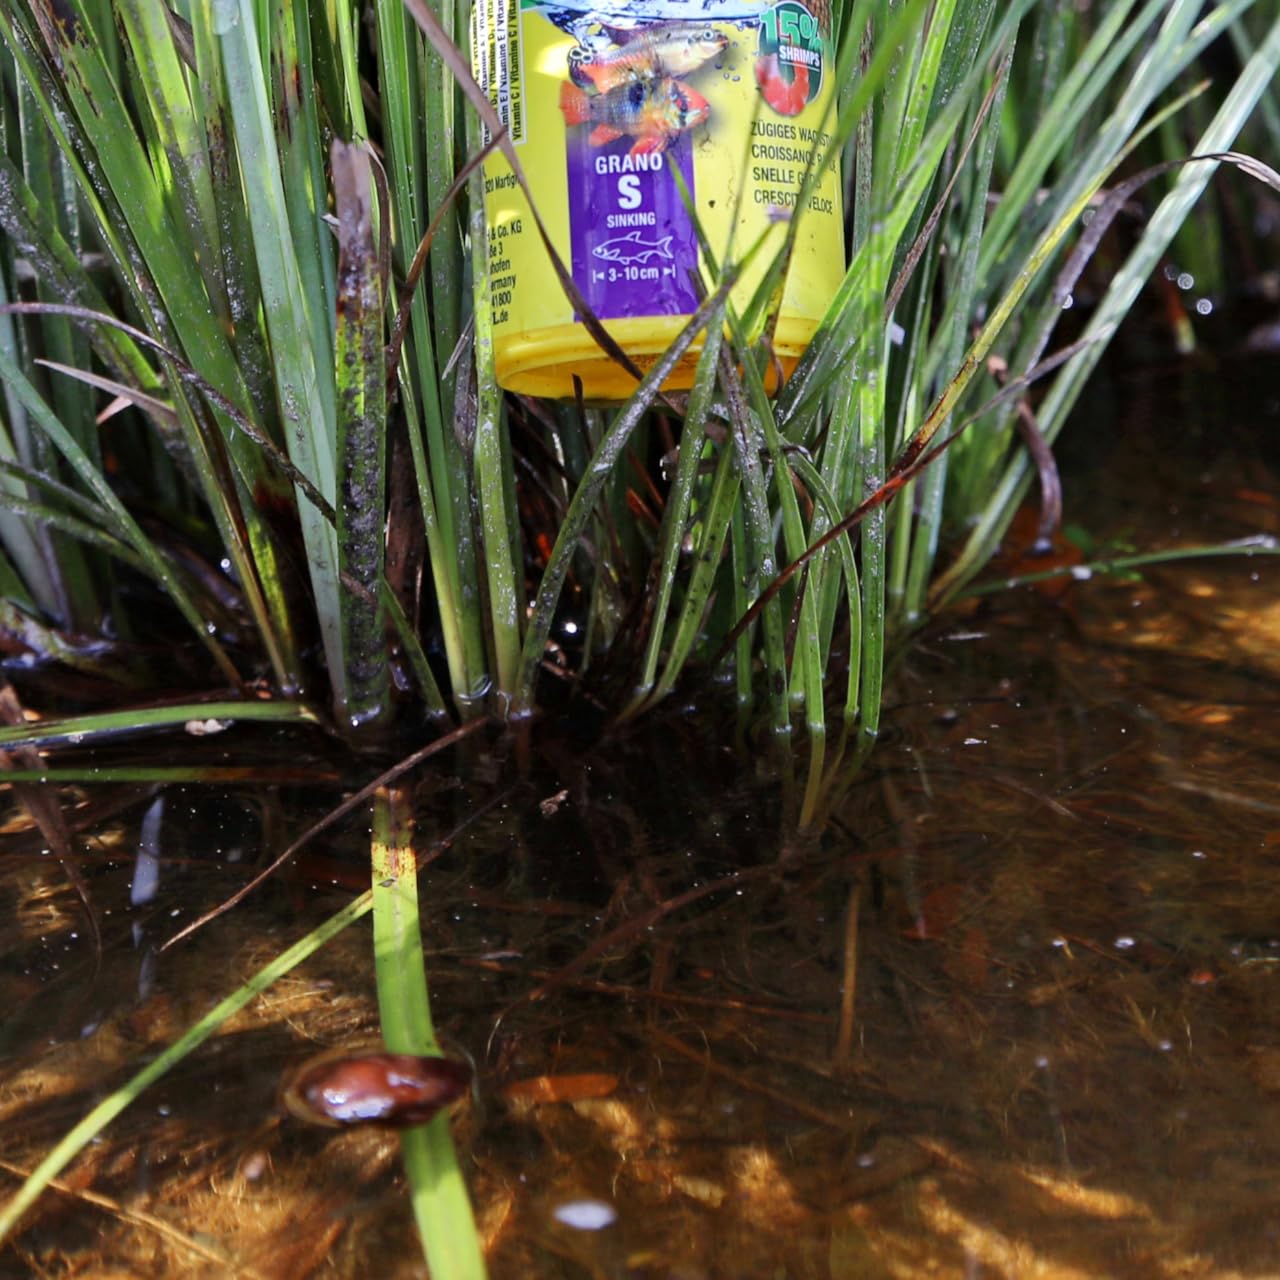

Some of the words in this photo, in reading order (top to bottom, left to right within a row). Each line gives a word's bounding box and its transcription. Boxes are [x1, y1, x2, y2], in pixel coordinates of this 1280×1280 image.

[760, 6, 822, 51] 15%
[508, 40, 518, 84] Vitamine
[779, 44, 821, 67] SHRIMPS
[512, 102, 522, 142] Vitamin
[751, 119, 797, 140] ZÜGIGES
[595, 152, 663, 174] GRANO
[753, 166, 796, 184] SNELLE
[618, 174, 642, 210] S
[754, 188, 801, 207] CRESCIT
[498, 224, 510, 238] Co.
[511, 219, 522, 235] KG
[606, 212, 656, 228] SINKING
[490, 274, 517, 292] ermany
